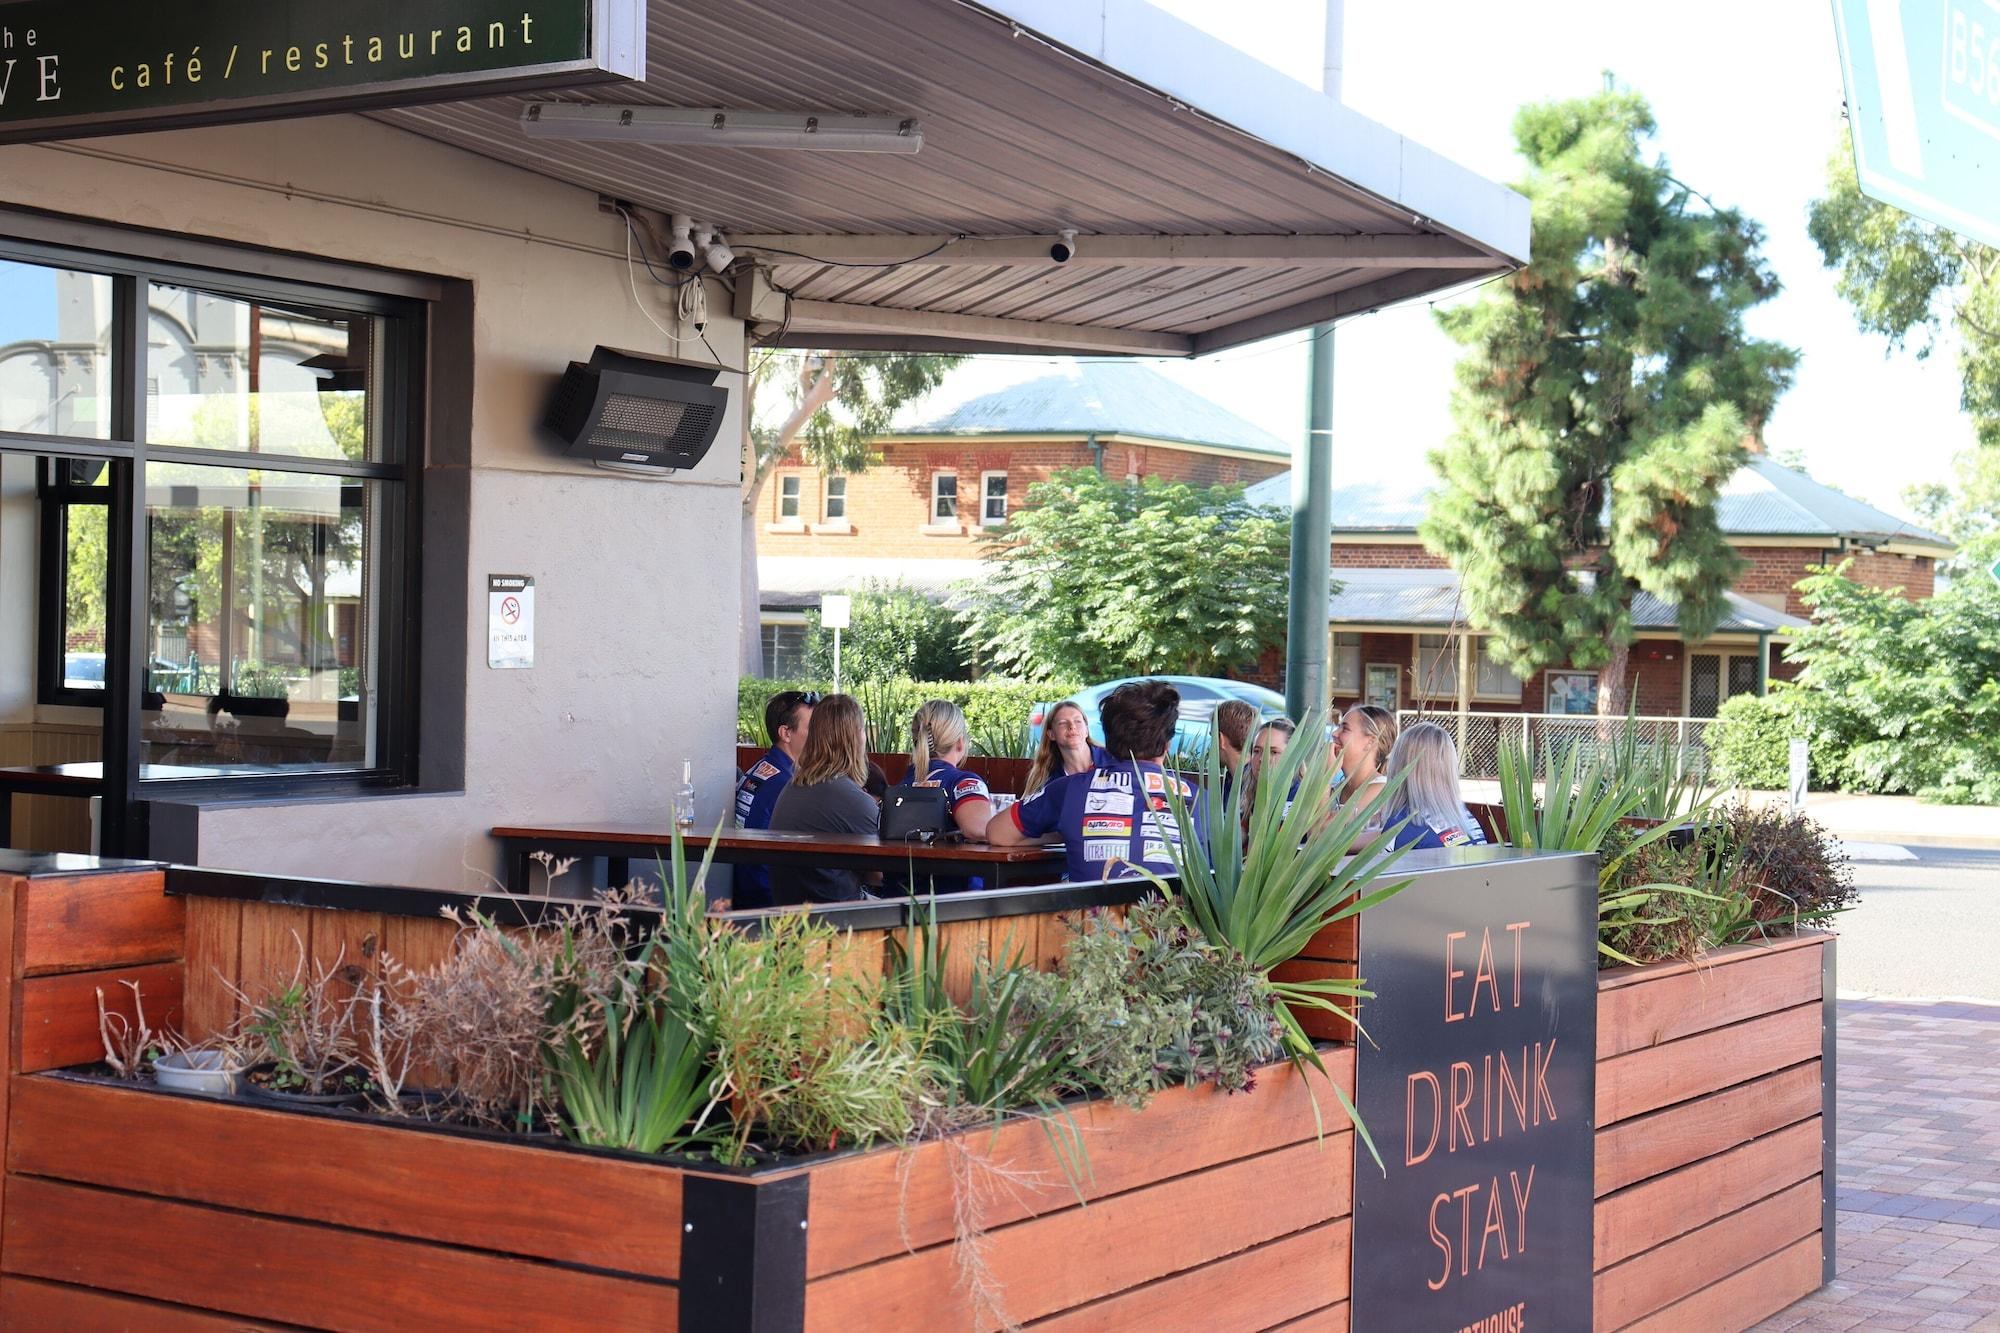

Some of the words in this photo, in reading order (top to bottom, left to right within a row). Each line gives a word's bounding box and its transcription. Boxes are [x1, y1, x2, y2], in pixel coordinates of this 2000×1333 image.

[110, 46, 201, 90] café
[261, 12, 533, 75] restaurant
[501, 579, 525, 587] SMOKING
[1444, 921, 1531, 1023] EAT
[1405, 1038, 1558, 1167] DRINK
[1427, 1164, 1536, 1292] STAY
